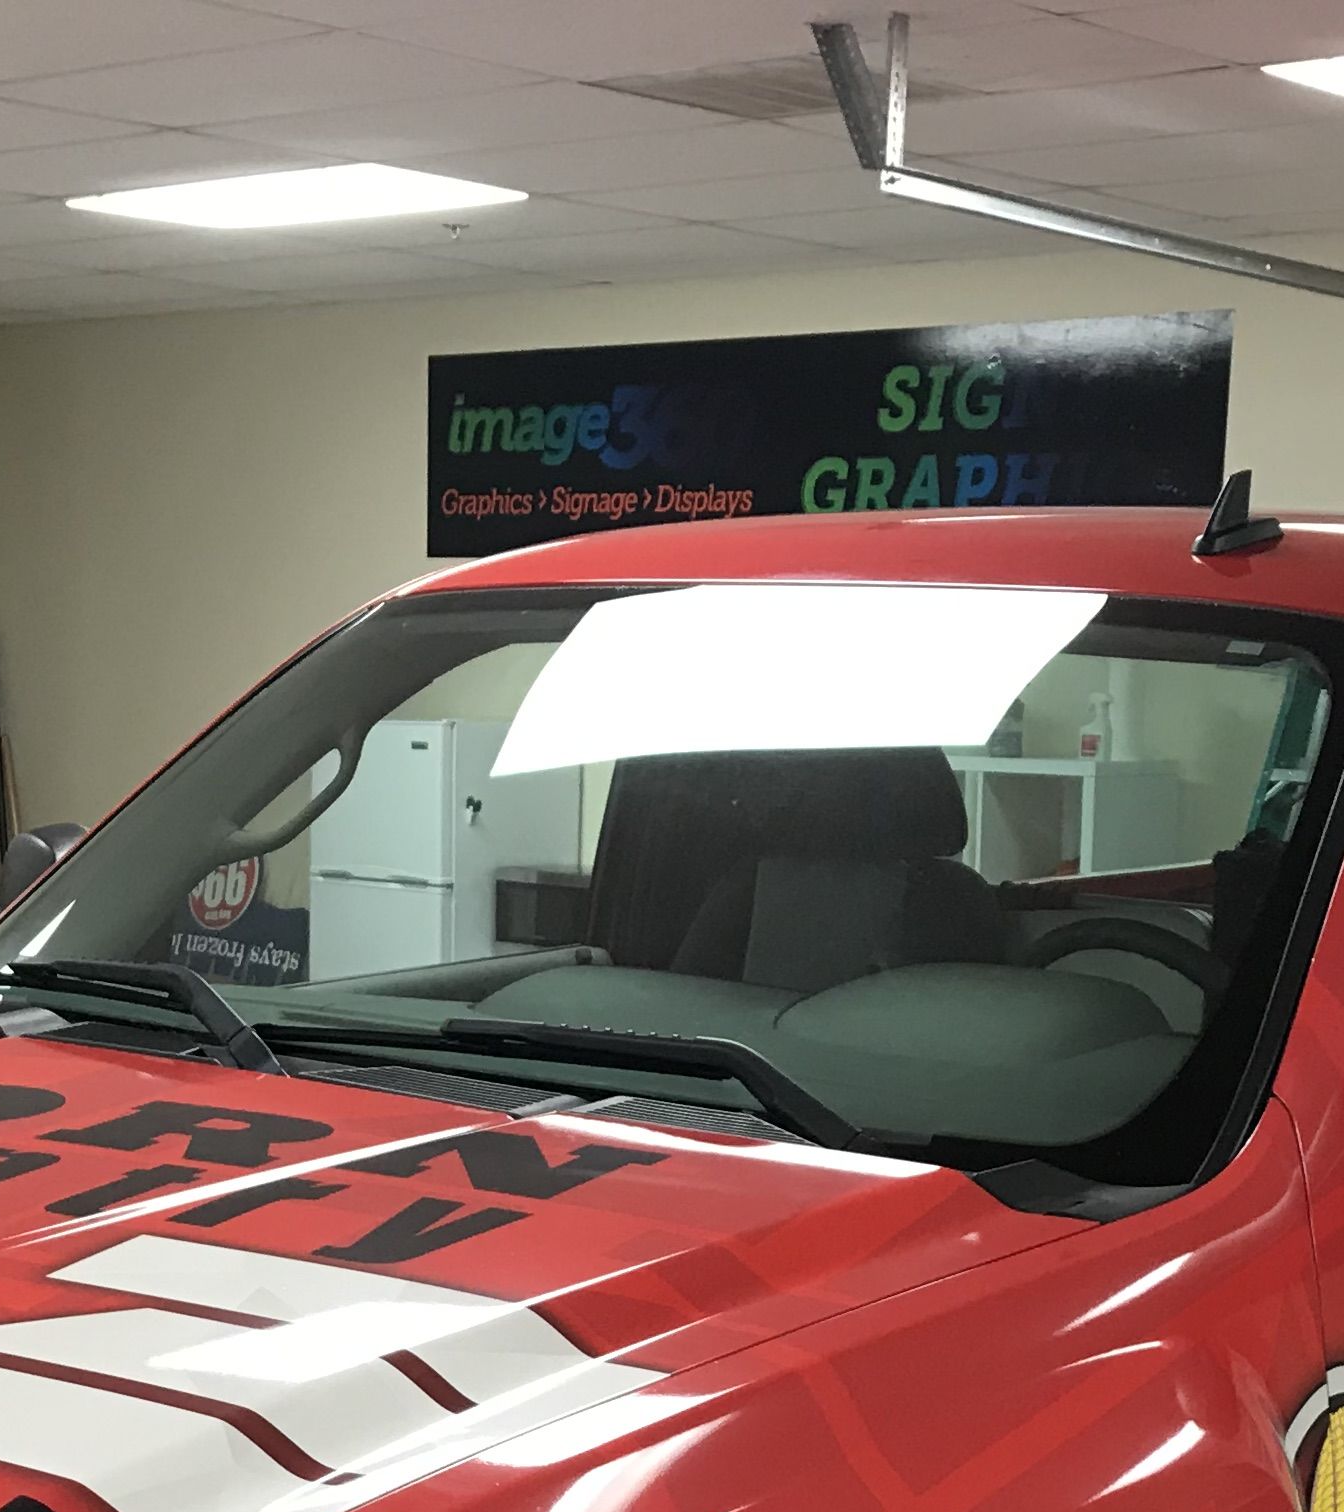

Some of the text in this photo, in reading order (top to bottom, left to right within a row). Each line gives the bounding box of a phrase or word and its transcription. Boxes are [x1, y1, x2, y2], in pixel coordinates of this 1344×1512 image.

[440, 482, 754, 521] Graphics Signage Displays
[186, 934, 245, 967] frozen
[249, 939, 302, 973] stays
